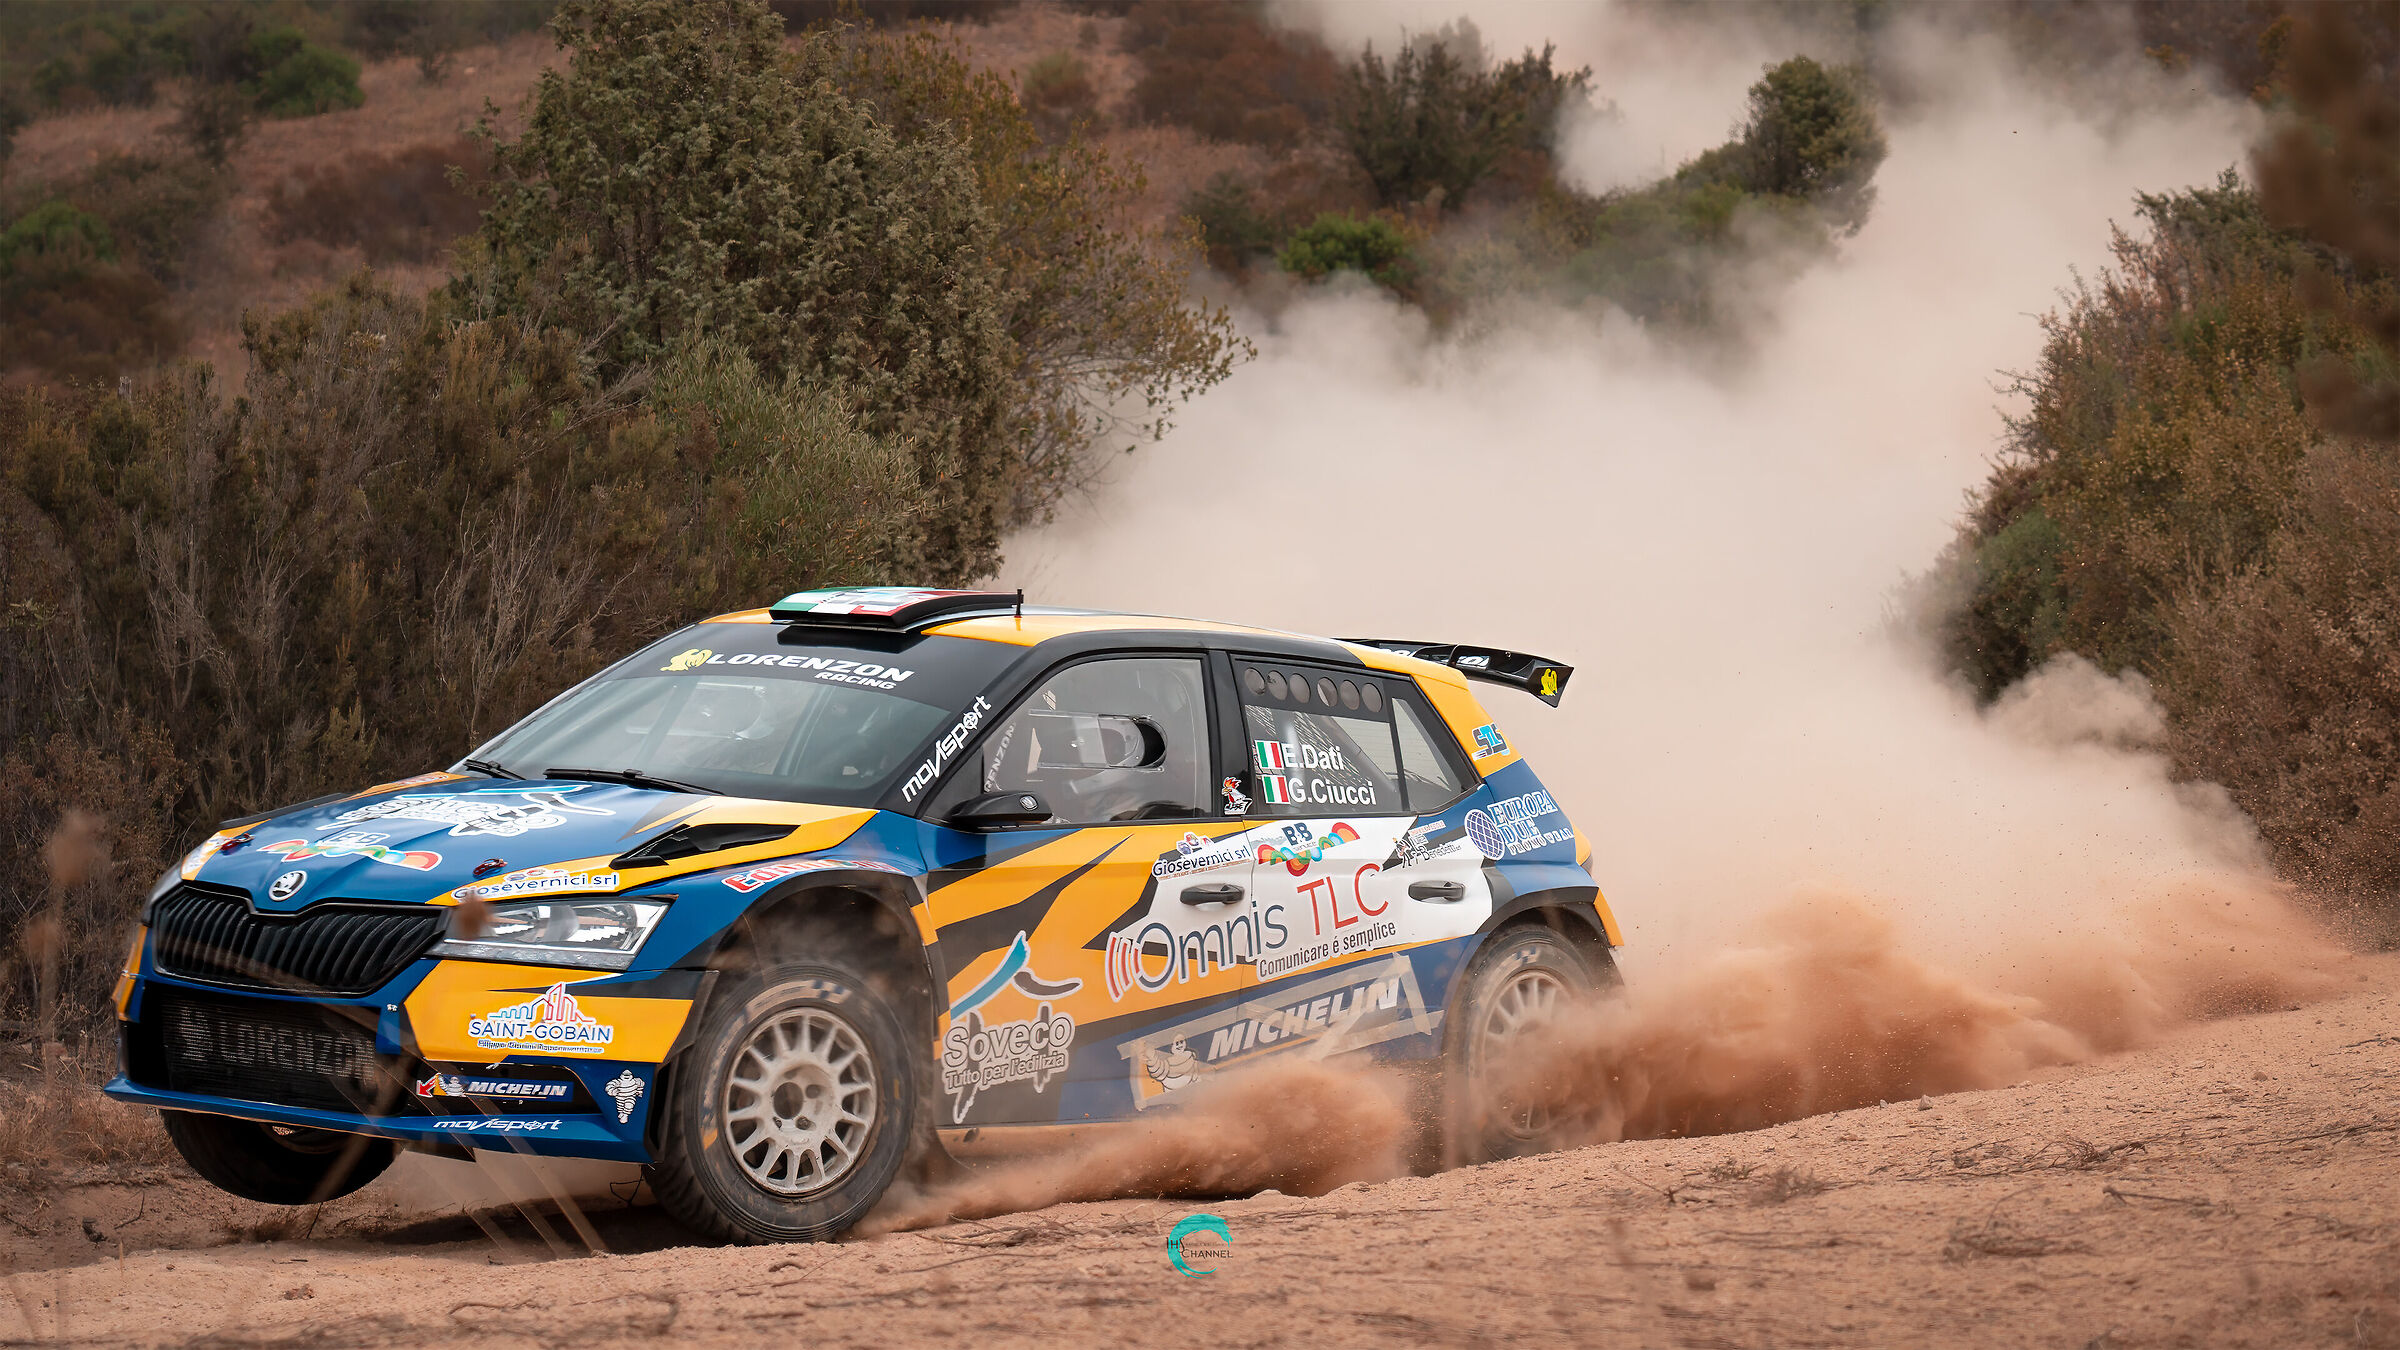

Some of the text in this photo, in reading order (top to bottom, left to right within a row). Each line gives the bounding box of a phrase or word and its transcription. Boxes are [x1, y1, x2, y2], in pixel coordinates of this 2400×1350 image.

[706, 652, 915, 682] LORENZON
[813, 671, 897, 691] RACING
[1283, 743, 1345, 771] E.Dati
[1288, 777, 1377, 806] G.Ciucci
[1489, 790, 1559, 825] EUROPA
[1498, 818, 1540, 845] DUE
[1234, 845, 1251, 860] srl
[592, 874, 617, 886] srl
[1133, 863, 1390, 987] Omnis TLC
[1259, 941, 1329, 978] Comunicare
[1342, 921, 1396, 951] semplice
[471, 1020, 612, 1042] SAINT-GOBAIN
[1206, 977, 1402, 1062] MICHELIN
[945, 1016, 1073, 1068] Soveco
[467, 1081, 567, 1096] MICHELIN
[945, 1068, 981, 1089] Tutto
[982, 1063, 1009, 1086] per
